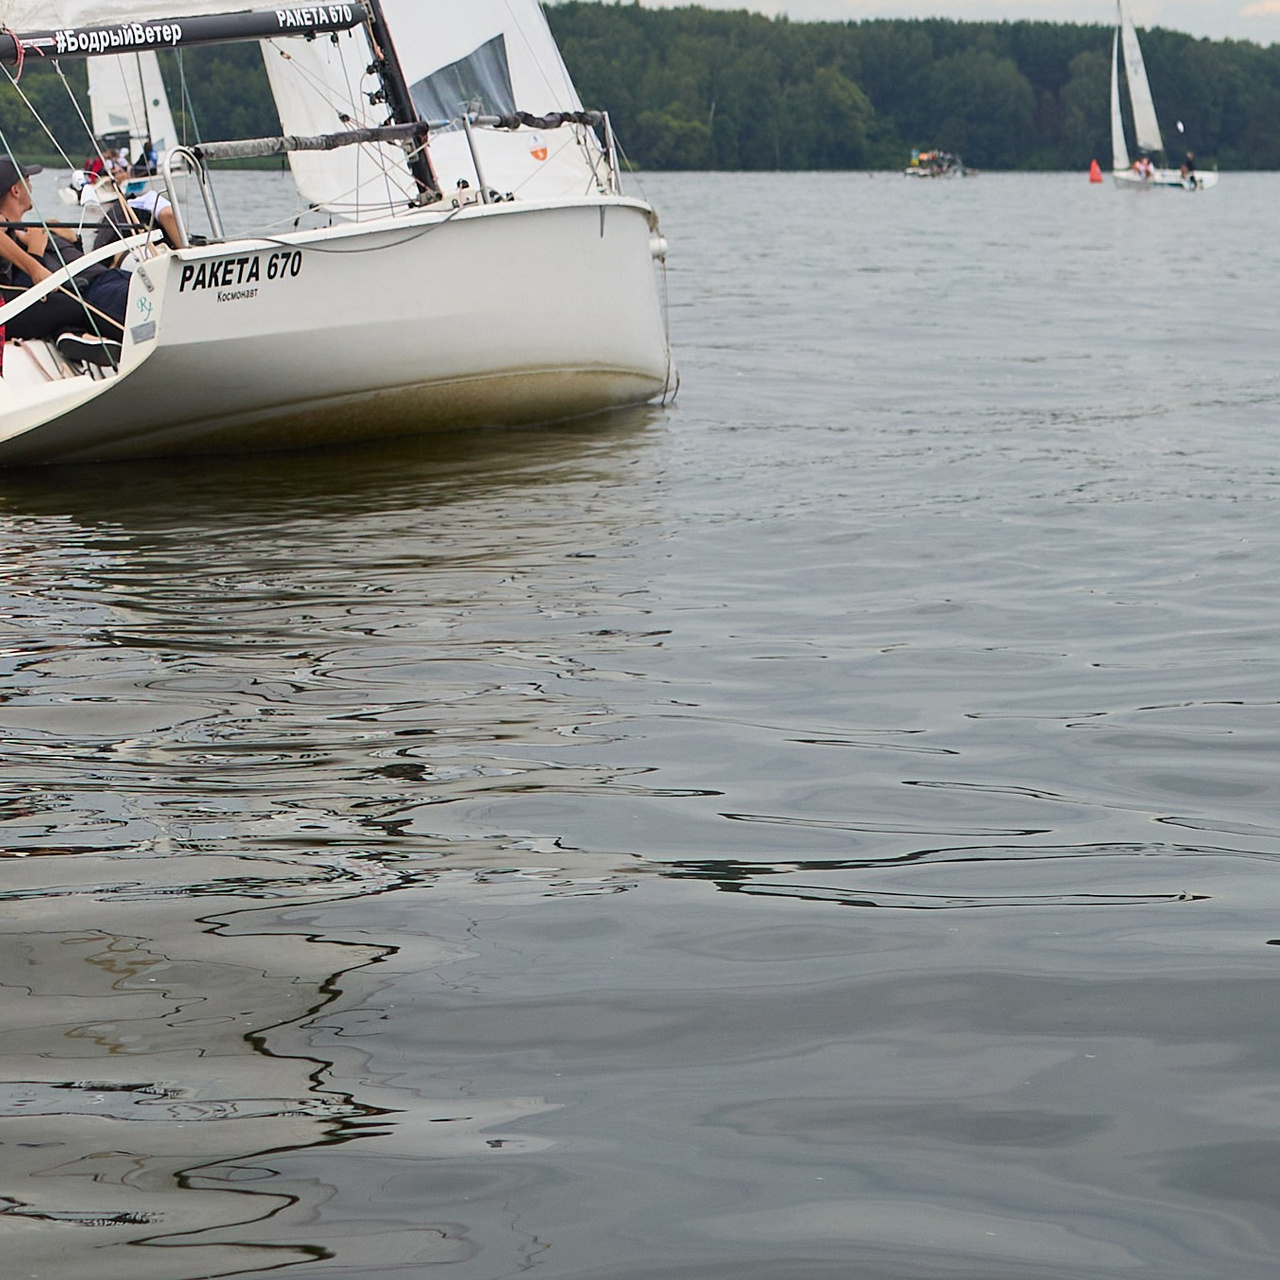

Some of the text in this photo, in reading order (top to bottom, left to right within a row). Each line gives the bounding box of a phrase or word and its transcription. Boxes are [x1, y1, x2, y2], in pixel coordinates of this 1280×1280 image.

[275, 4, 353, 28] РАКЕТА 670
[55, 23, 182, 54] #БодрыйВетер
[179, 250, 302, 292] РАКЕТА 670
[217, 288, 258, 302] Космонавт
